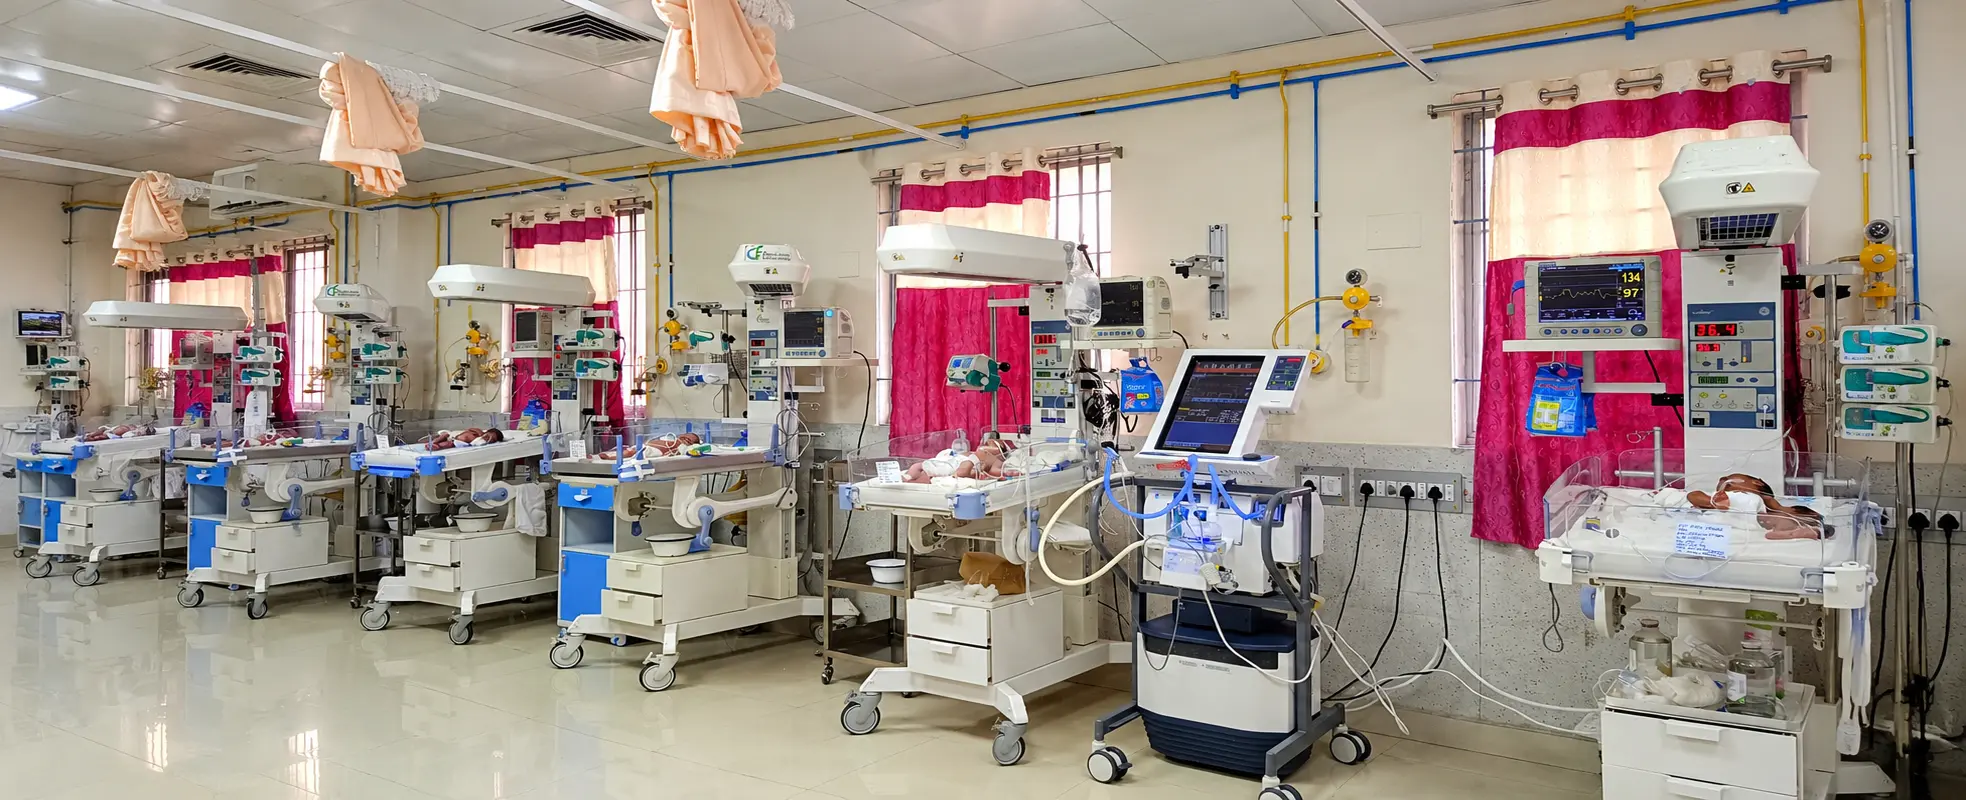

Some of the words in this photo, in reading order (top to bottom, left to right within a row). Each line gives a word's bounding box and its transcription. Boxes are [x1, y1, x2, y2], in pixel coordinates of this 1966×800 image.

[1622, 272, 1641, 283] 134
[1623, 288, 1639, 298] 97
[1696, 324, 1735, 337] 36.4
